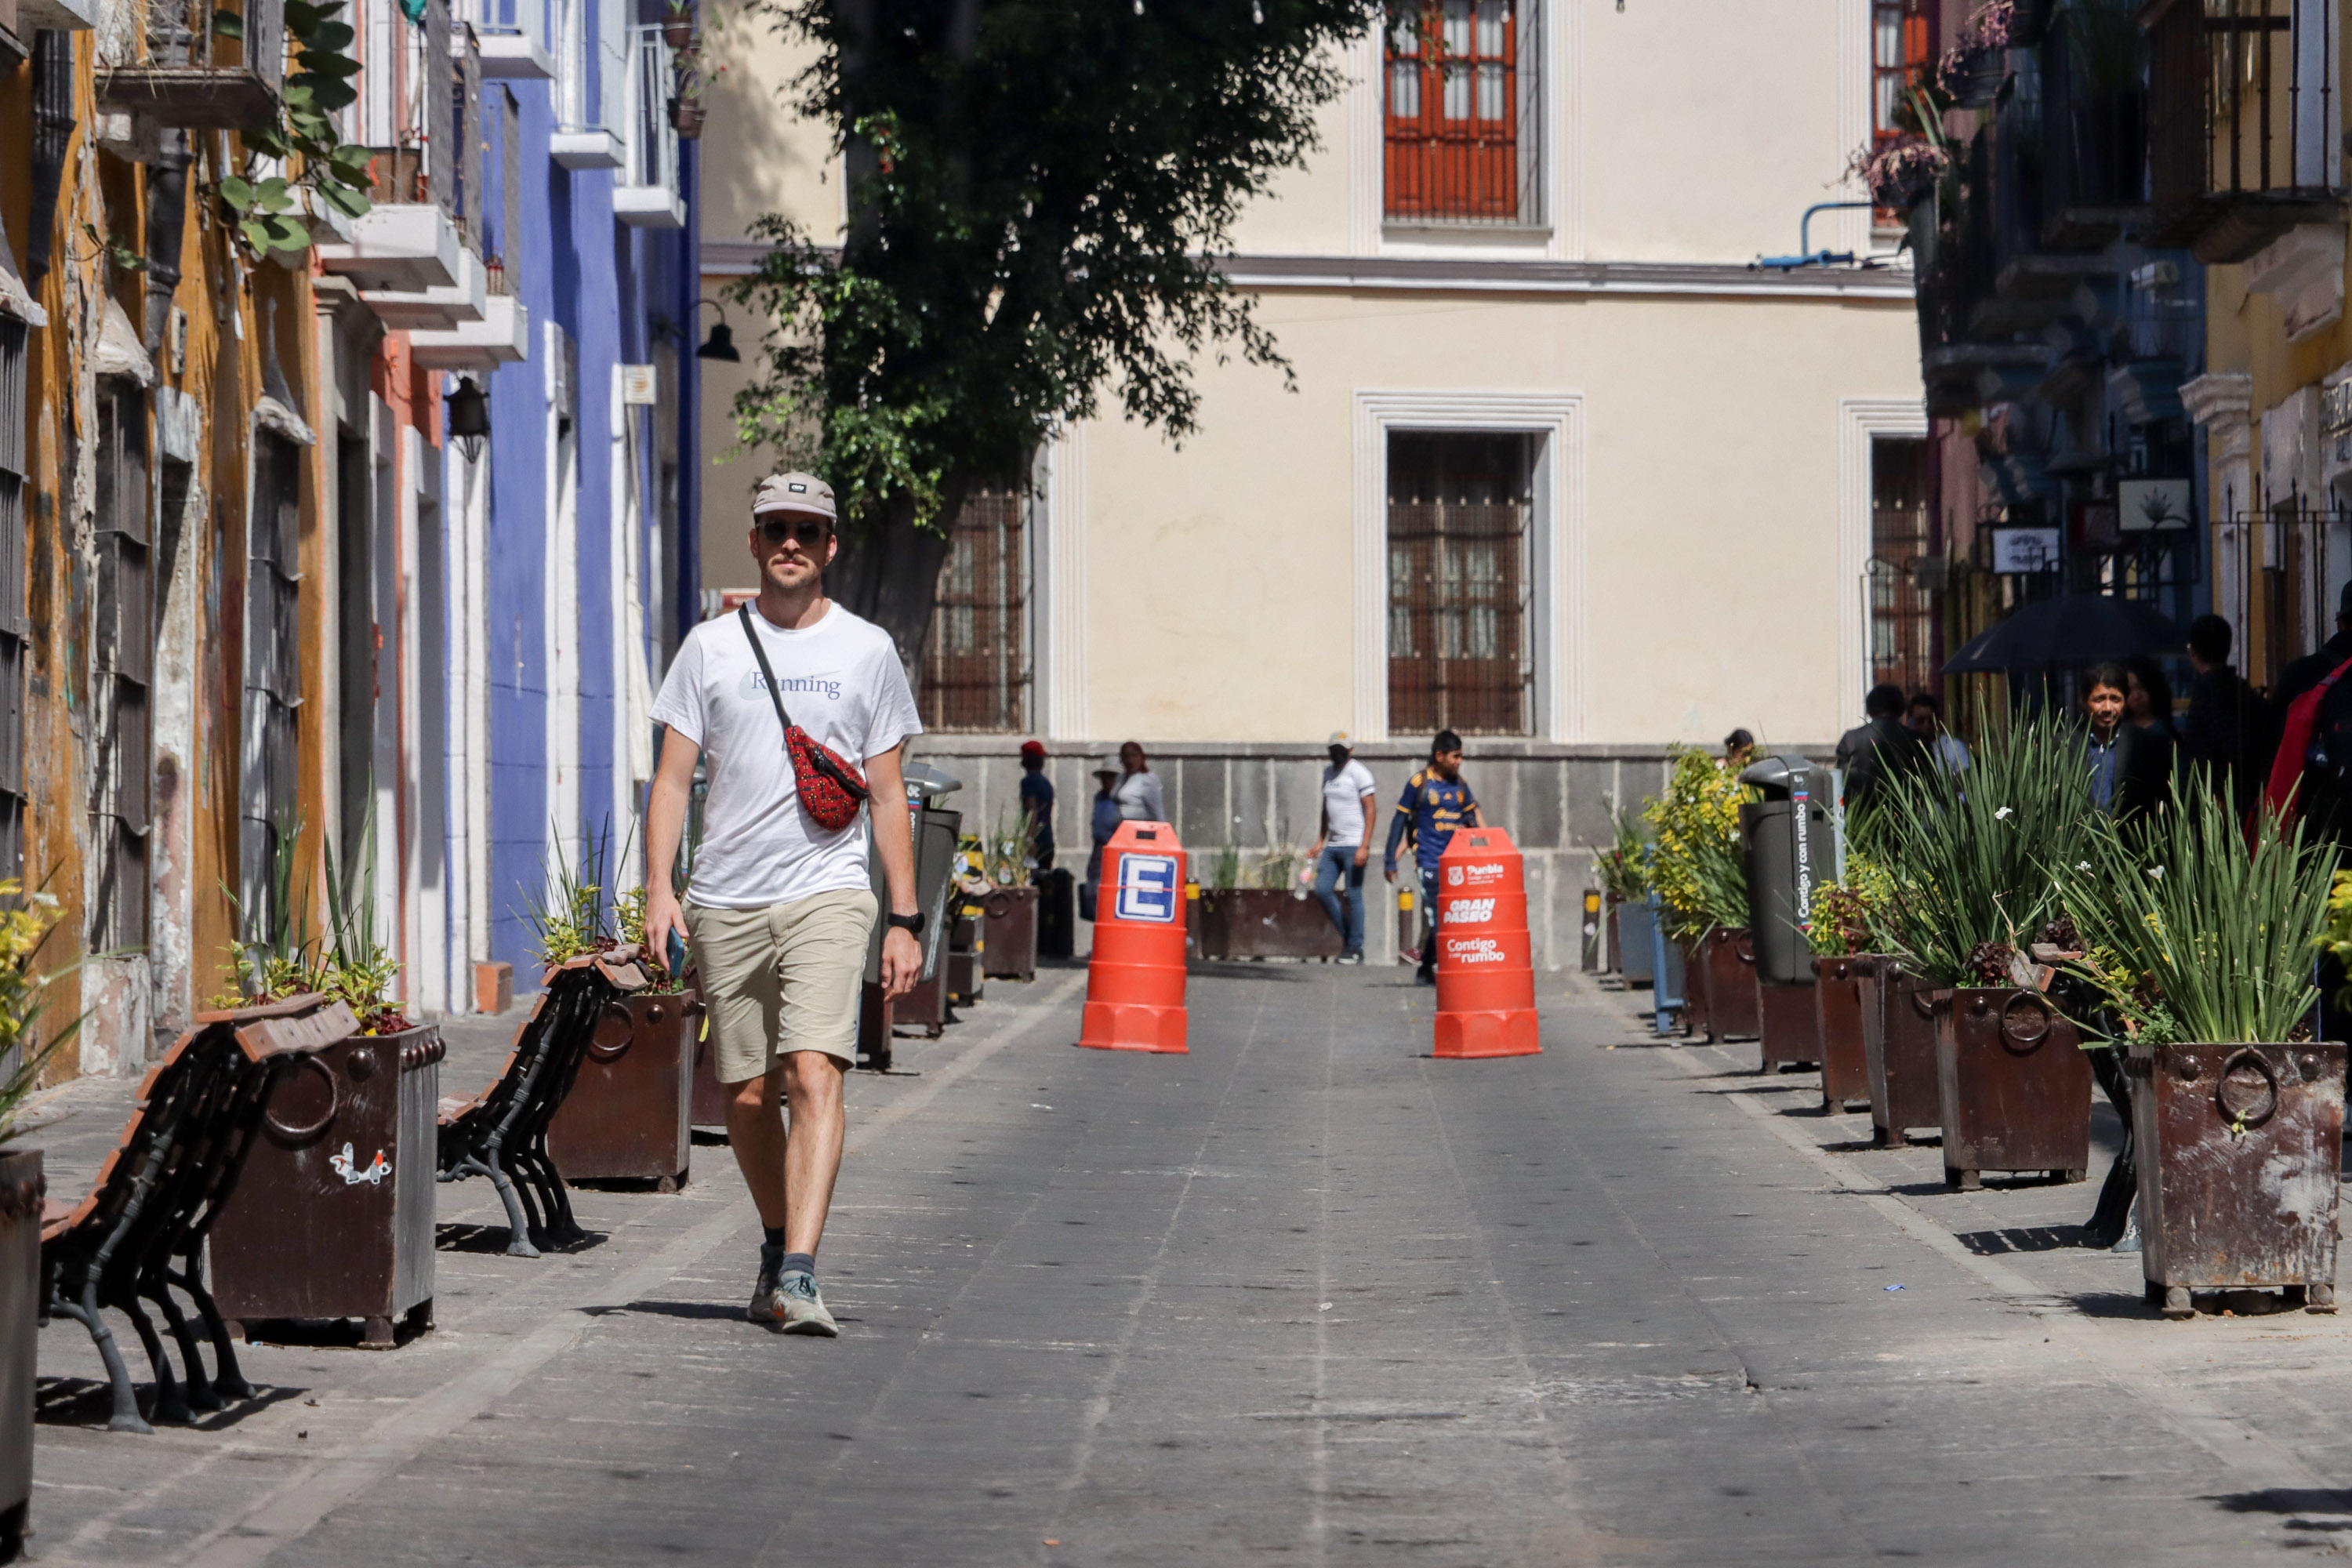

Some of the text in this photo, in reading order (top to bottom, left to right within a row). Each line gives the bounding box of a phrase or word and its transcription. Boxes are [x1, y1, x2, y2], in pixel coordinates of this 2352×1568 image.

[752, 671, 841, 700] Rnning
[1795, 804, 1807, 842] rumbo
[1466, 863, 1504, 875] Puebla
[1799, 864, 1811, 873] y
[1123, 859, 1167, 916] E
[1798, 873, 1811, 918] Contigo
[1450, 898, 1496, 912] GRAN
[1443, 909, 1493, 924] PASEO
[1446, 937, 1497, 953] Contigo
[1461, 950, 1505, 964] rumbo
